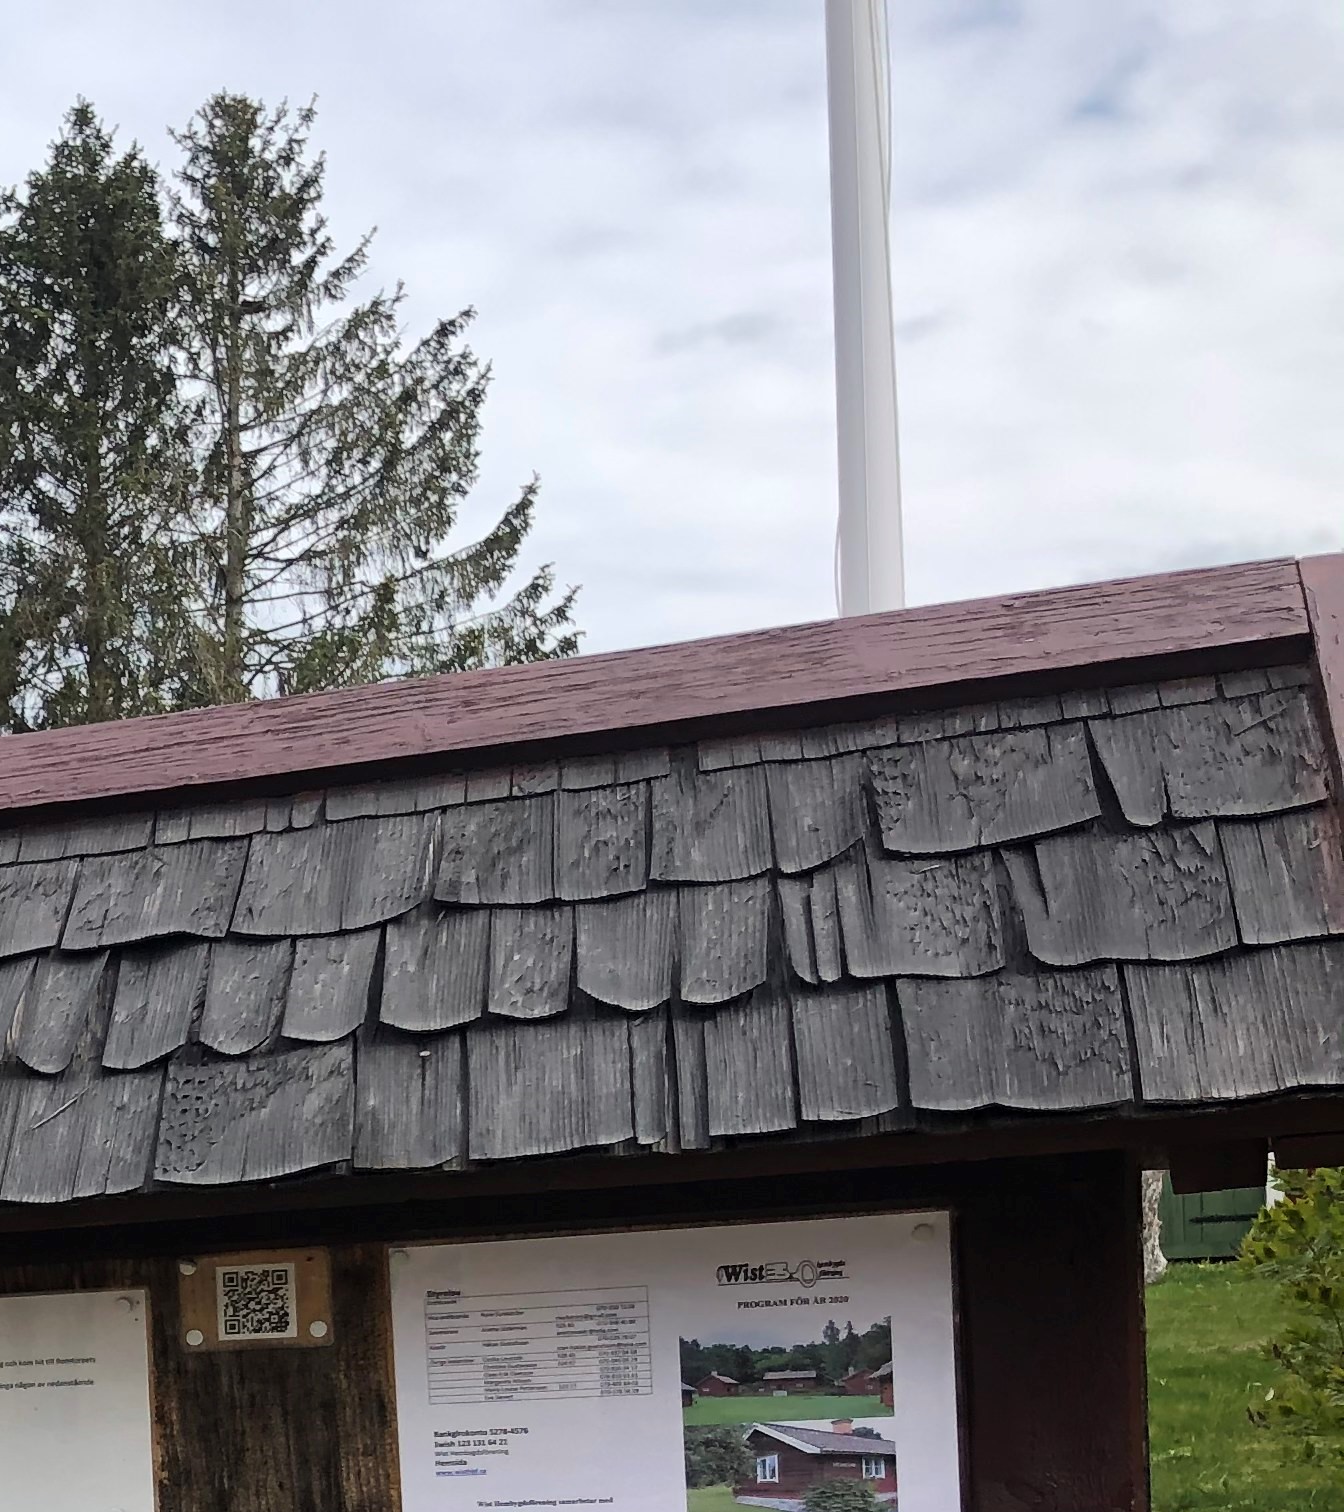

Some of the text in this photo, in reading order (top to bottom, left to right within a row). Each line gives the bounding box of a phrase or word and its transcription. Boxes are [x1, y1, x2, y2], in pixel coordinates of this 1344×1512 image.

[717, 1263, 765, 1282] Wist
[738, 1300, 787, 1309] PROGRAM
[790, 1298, 809, 1306] FÖR
